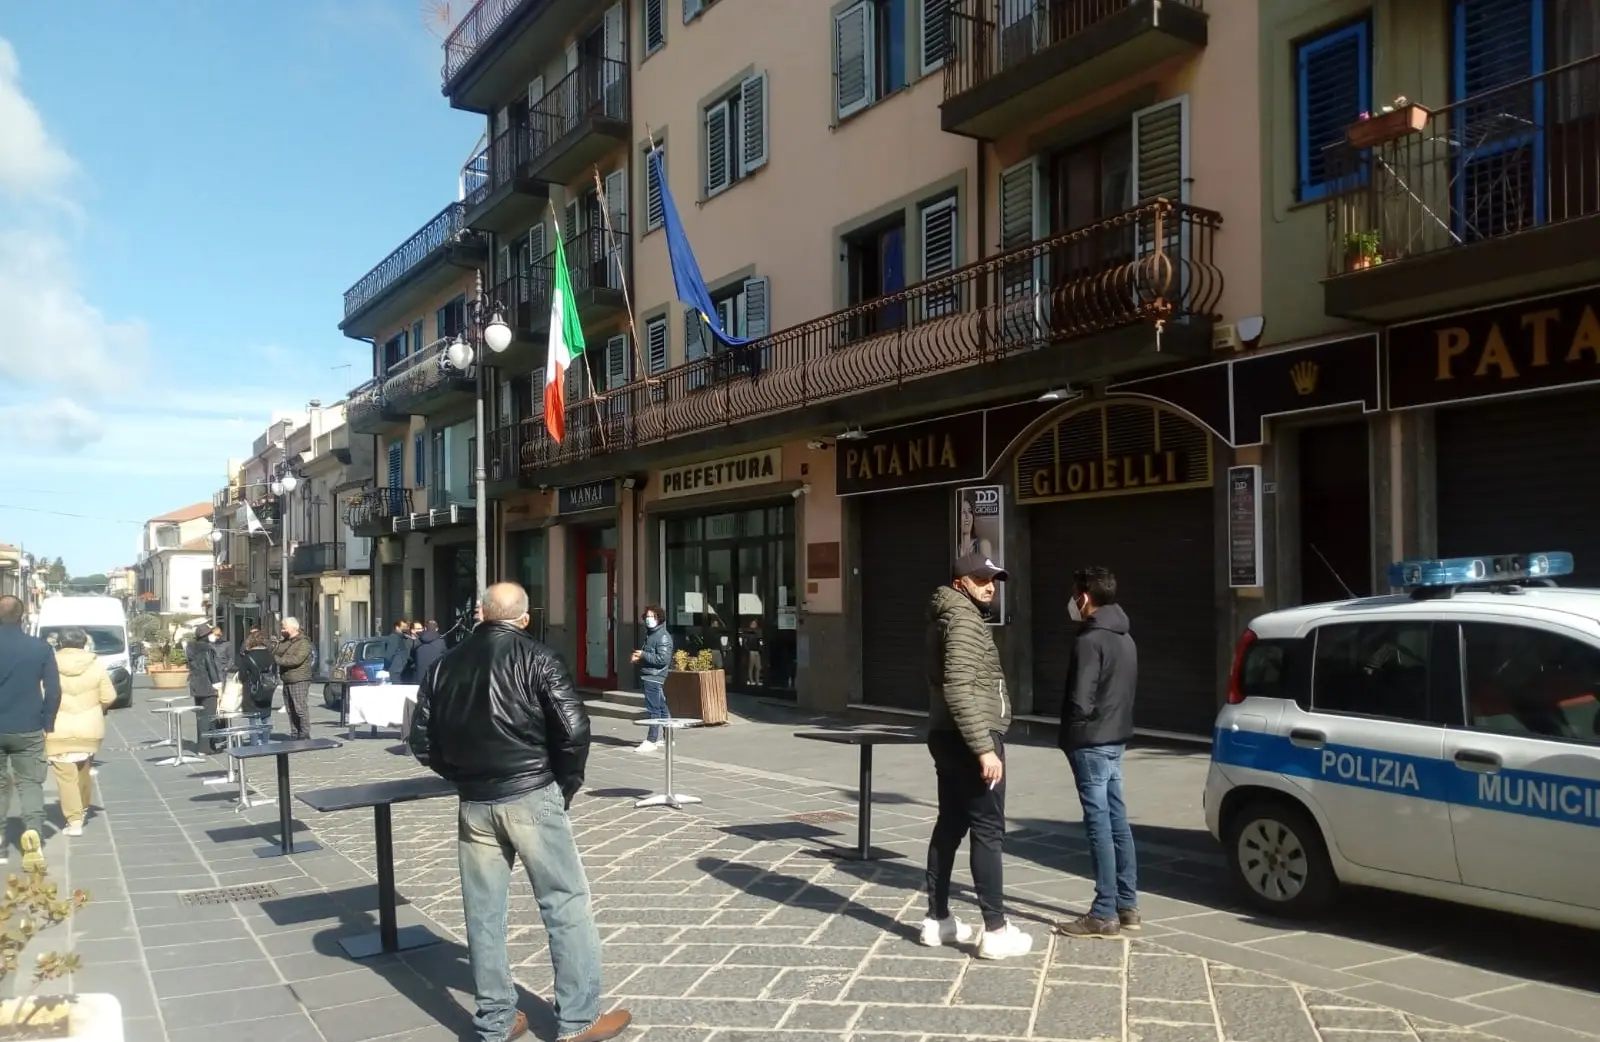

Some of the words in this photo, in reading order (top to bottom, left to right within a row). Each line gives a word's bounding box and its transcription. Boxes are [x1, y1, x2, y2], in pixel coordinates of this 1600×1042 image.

[663, 454, 774, 493] PREFETTURA
[845, 433, 957, 480] PATANIA
[1032, 450, 1177, 496] GIOIELLI
[975, 490, 998, 503] DD
[1320, 749, 1420, 791] POLIZIA
[1478, 773, 1600, 819] MUNICI
